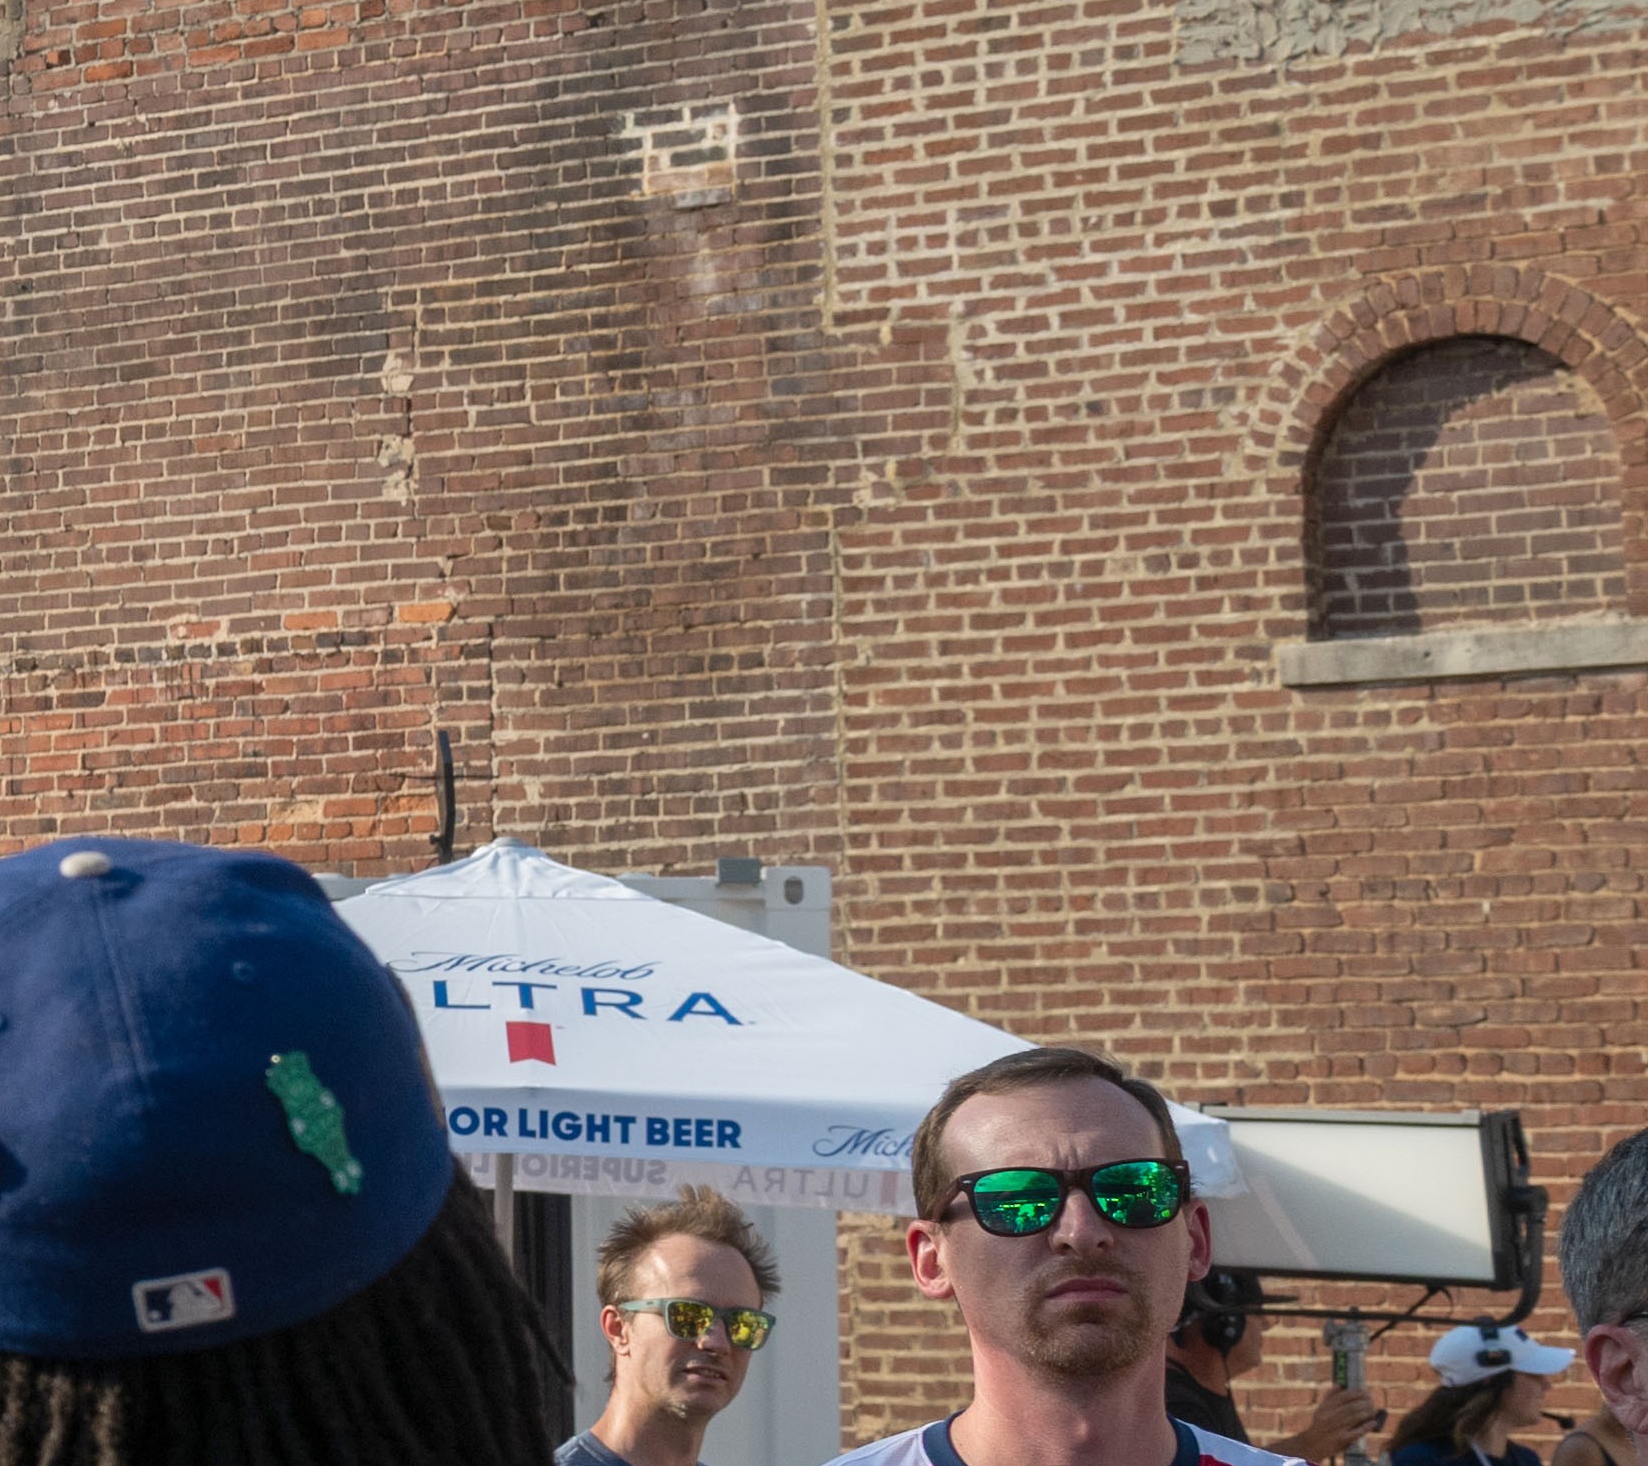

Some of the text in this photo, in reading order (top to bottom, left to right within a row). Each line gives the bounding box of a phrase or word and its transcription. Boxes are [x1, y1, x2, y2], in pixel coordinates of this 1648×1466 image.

[387, 951, 662, 980] Michelob
[433, 980, 744, 1026] LTRA
[518, 1108, 637, 1144] LIGHT
[646, 1117, 742, 1150] BEER
